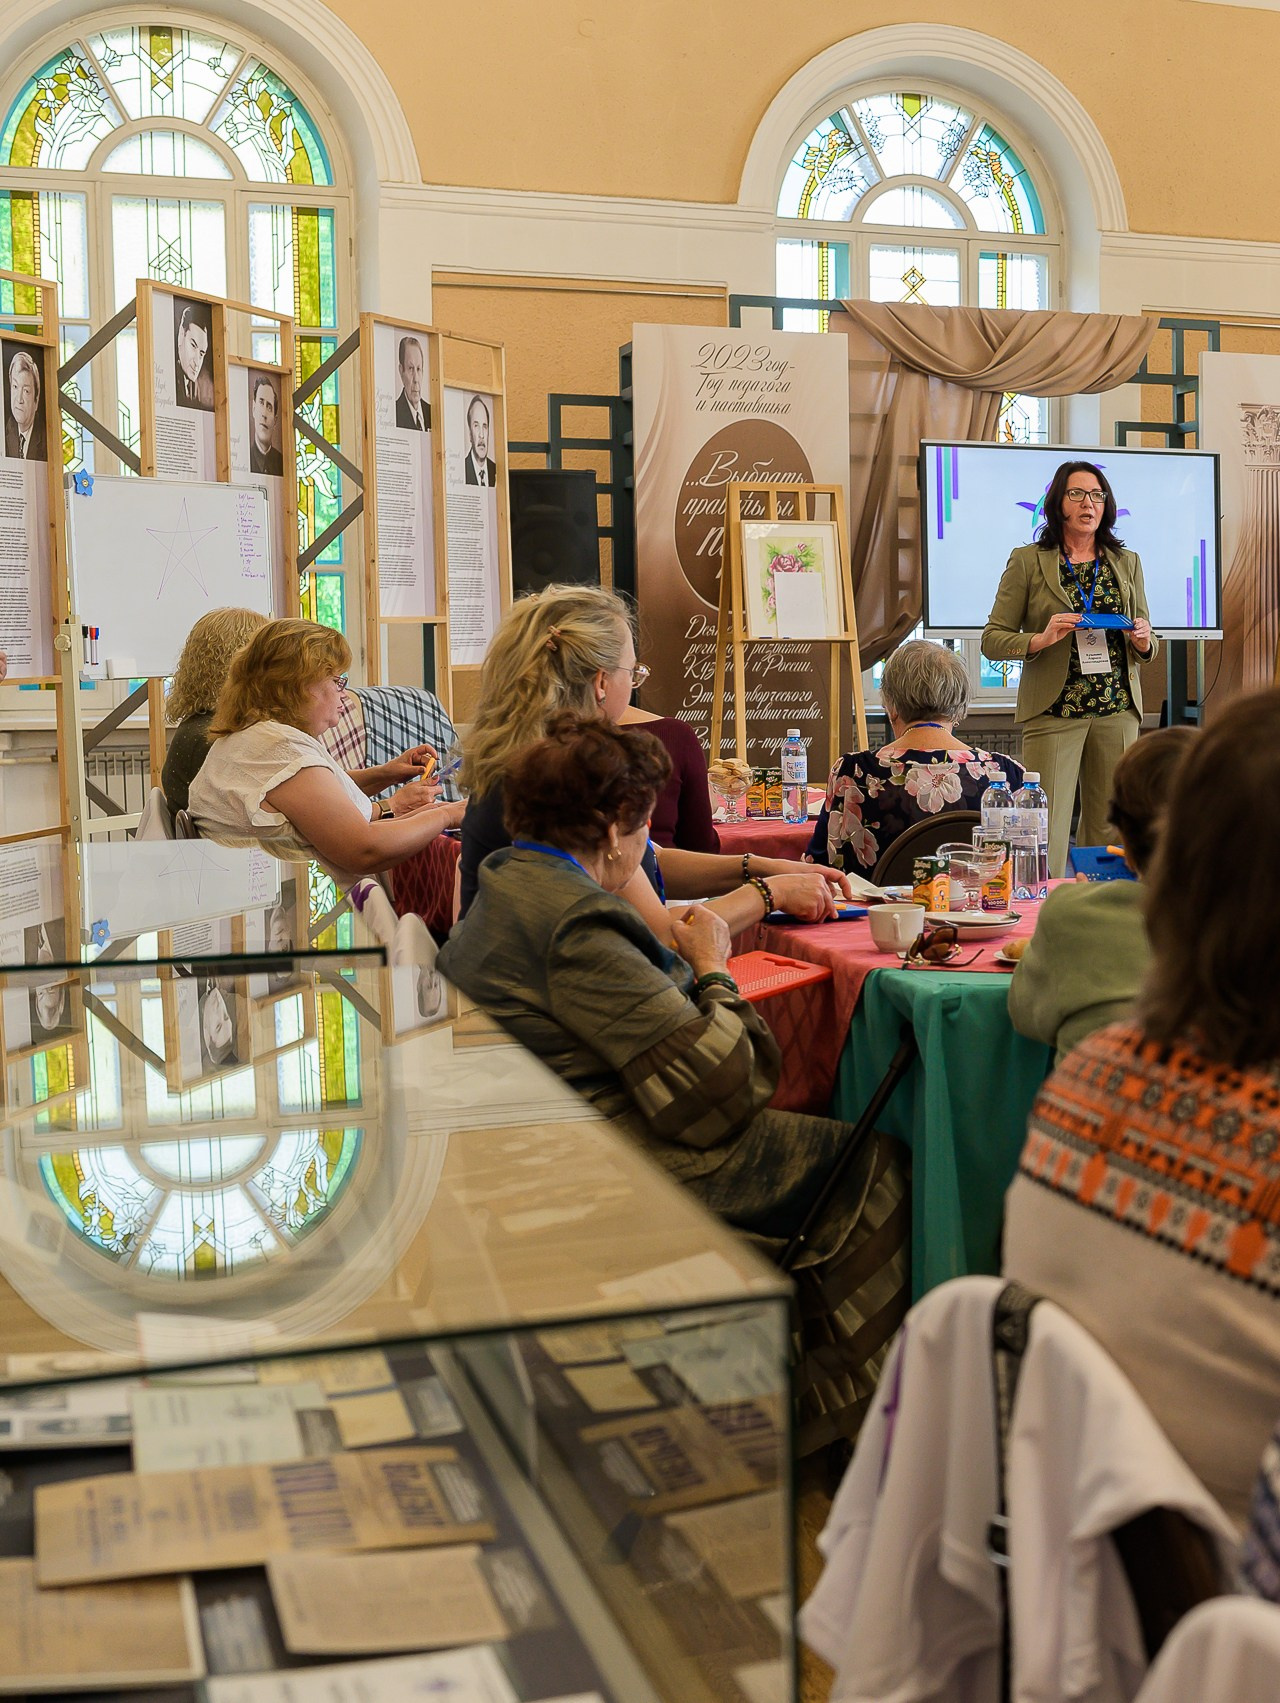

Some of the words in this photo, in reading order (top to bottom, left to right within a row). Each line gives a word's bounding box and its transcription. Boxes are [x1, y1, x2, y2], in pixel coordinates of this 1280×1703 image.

[695, 371, 727, 399] Год
[728, 379, 791, 400] педагога
[695, 399, 707, 412] и
[710, 394, 791, 415] наставника
[762, 653, 814, 678] России.
